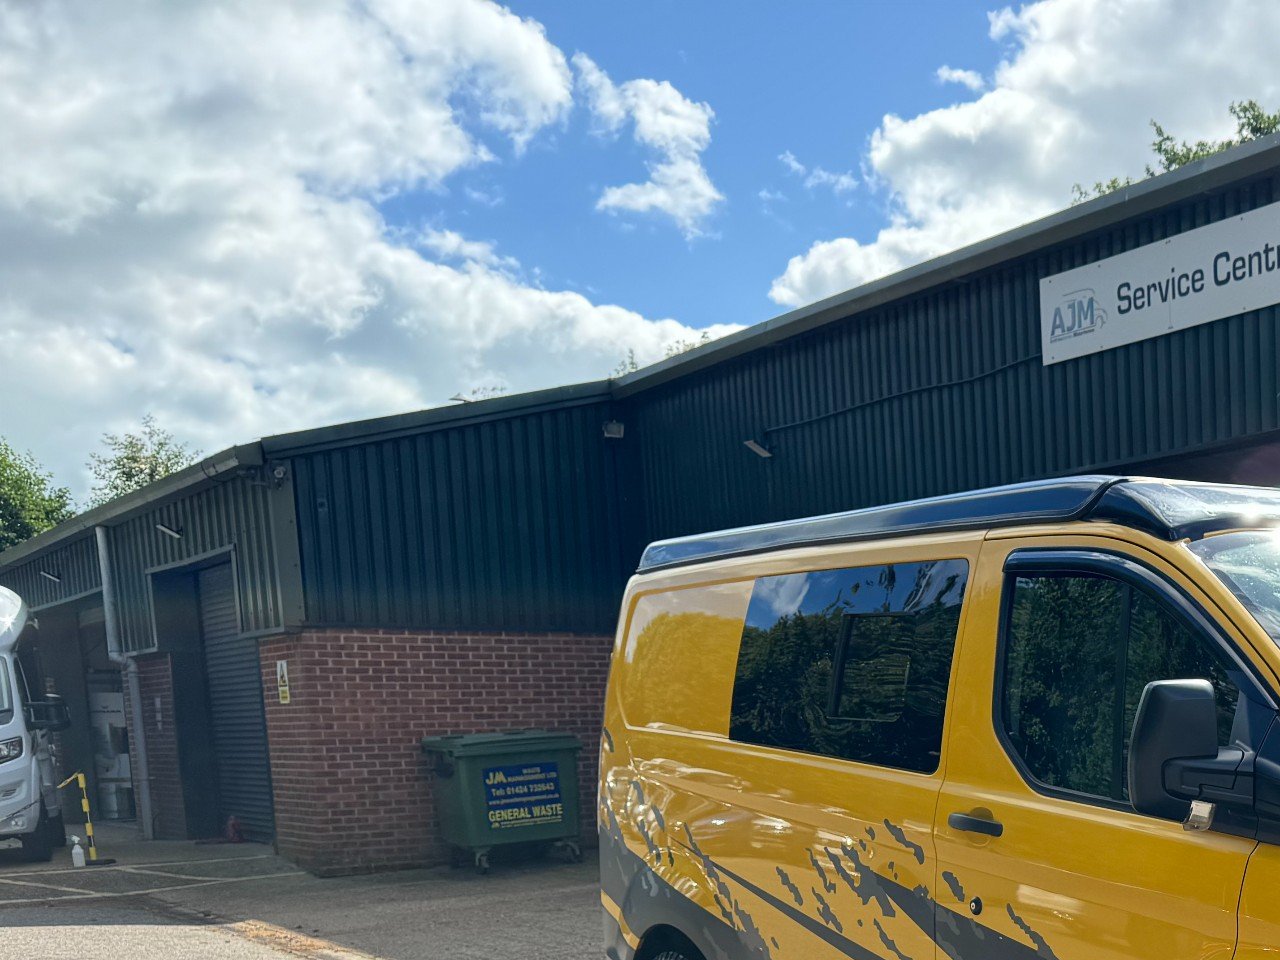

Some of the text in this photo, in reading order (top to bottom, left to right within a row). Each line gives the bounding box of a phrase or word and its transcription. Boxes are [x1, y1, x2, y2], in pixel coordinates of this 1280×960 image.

[1116, 267, 1204, 315] Service
[1050, 297, 1094, 337] AJM
[488, 806, 531, 822] GENERAL
[532, 803, 563, 818] WASTE
